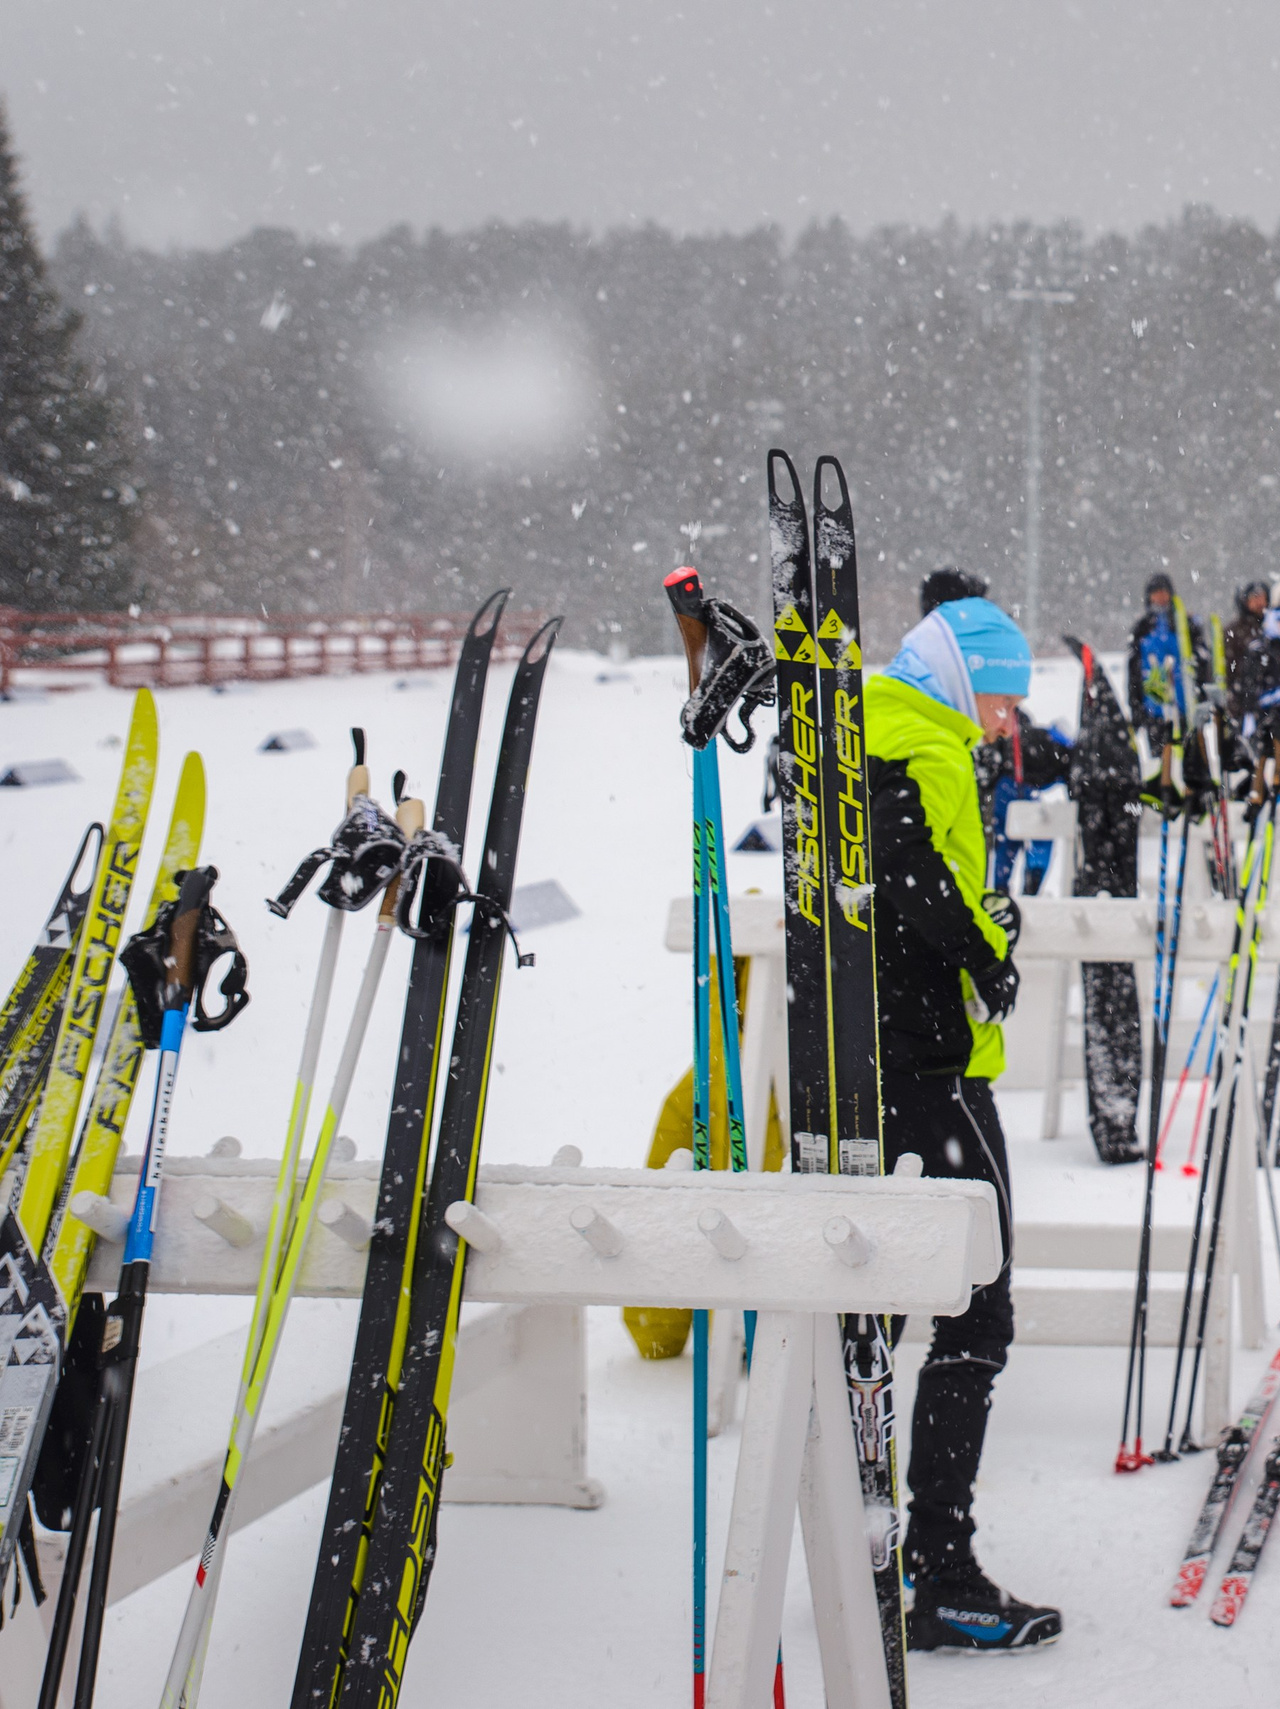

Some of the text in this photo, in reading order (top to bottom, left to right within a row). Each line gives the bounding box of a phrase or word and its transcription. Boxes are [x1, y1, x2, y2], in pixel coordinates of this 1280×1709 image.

[829, 619, 838, 633] 3
[791, 681, 821, 926] FISCHER
[57, 841, 140, 1080] FISCHER
[152, 1071, 175, 1180] hallenbarter
